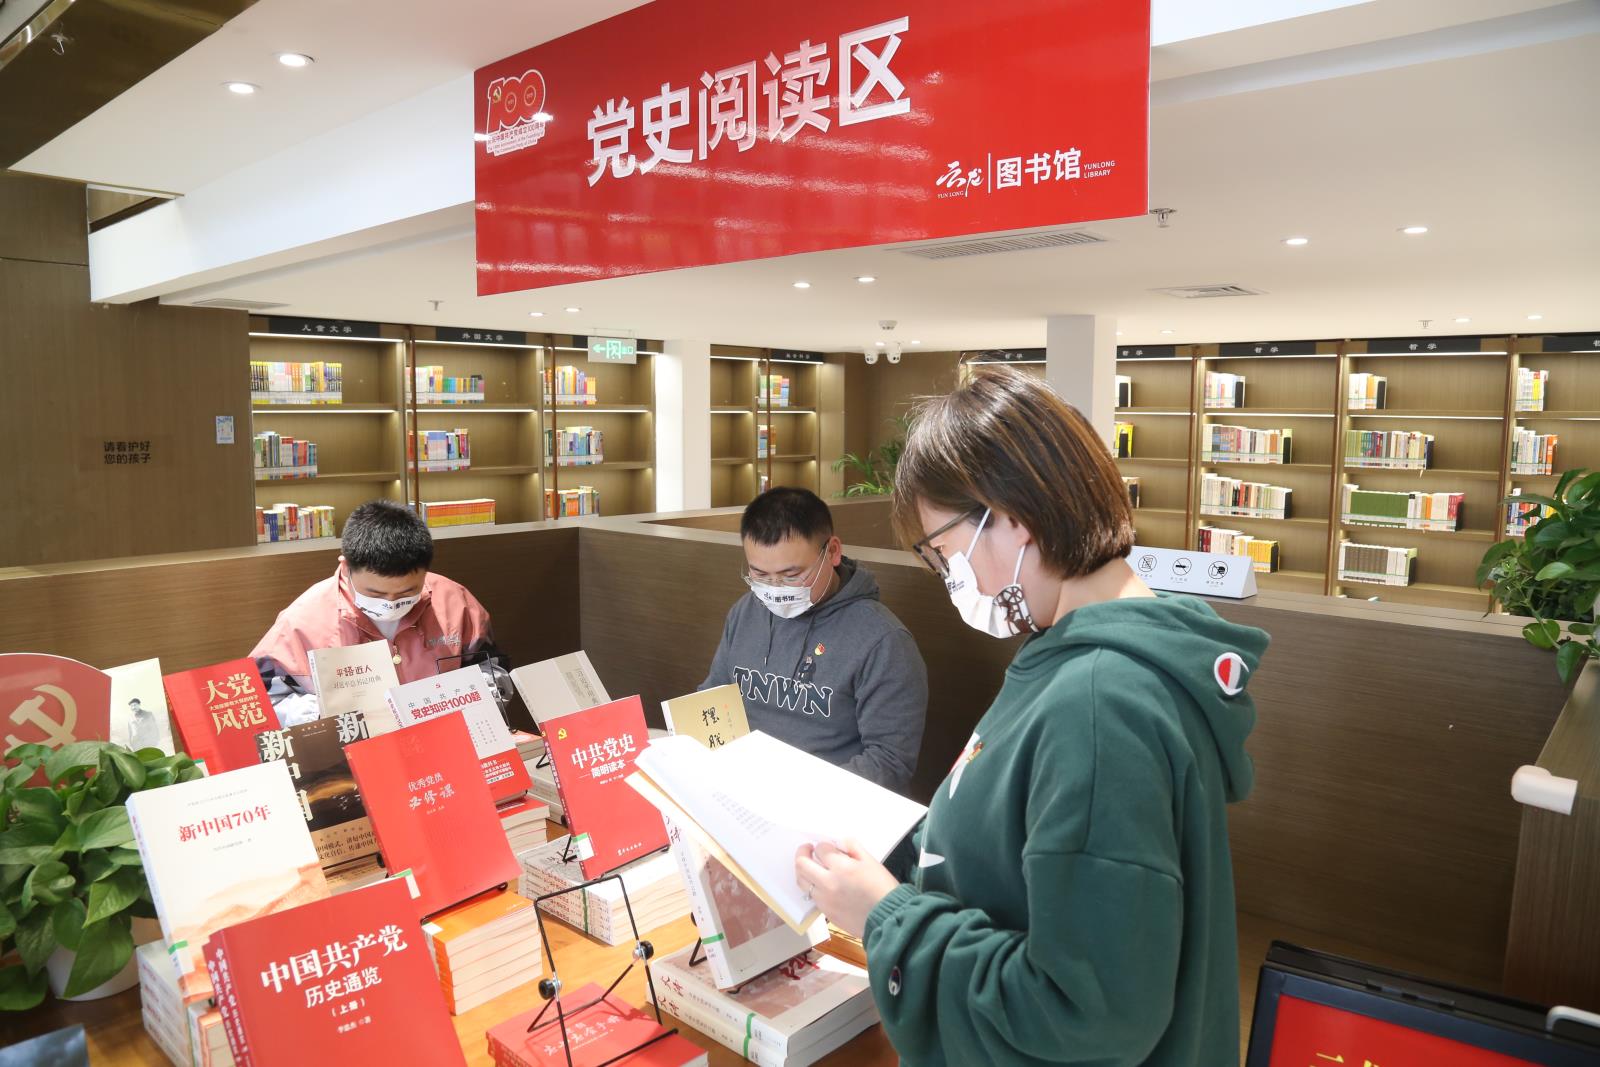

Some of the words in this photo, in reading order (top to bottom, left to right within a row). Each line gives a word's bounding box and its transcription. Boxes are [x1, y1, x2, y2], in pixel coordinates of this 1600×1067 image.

[586, 15, 911, 188] 党史阅读区
[996, 147, 1081, 189] 图书馆
[1083, 160, 1116, 170] YUNLONG
[1083, 169, 1111, 179] LIBRARY
[103, 440, 151, 452] 请看护好
[103, 452, 151, 465] 您的孩子
[201, 673, 256, 705] 大党
[411, 691, 482, 720] 党史知识1000题
[733, 665, 834, 718] TNWN
[212, 701, 268, 736] 风范
[571, 733, 636, 769] 中共党史
[408, 771, 444, 792] 优秀党员
[591, 759, 626, 779] 简明读本
[179, 804, 272, 842] 新中国70年
[261, 924, 408, 993] 中国共产党
[304, 966, 382, 1009] 历史通览
